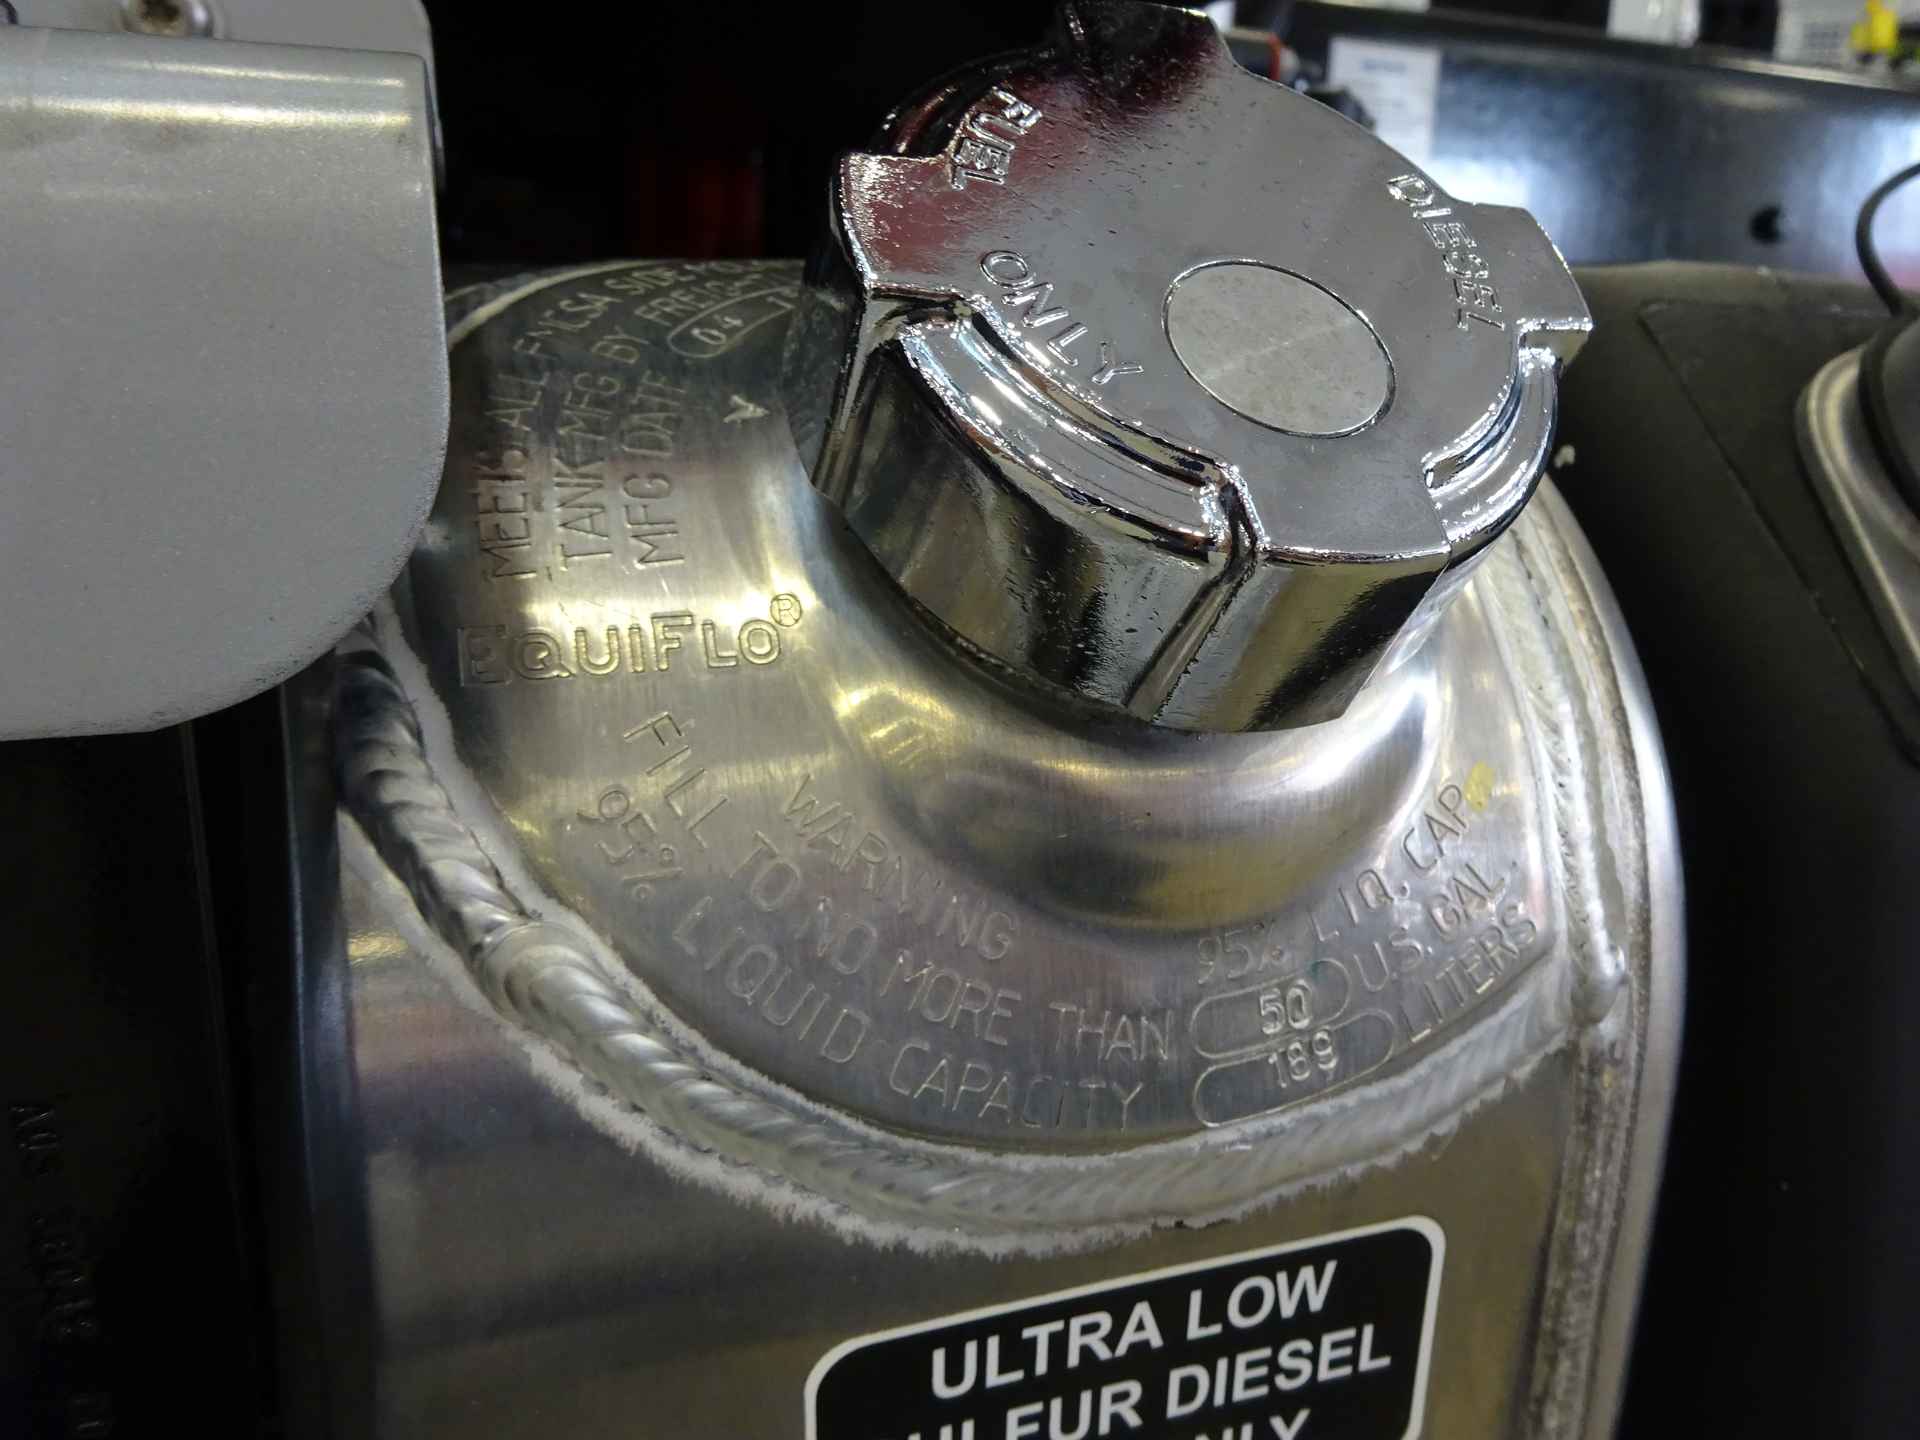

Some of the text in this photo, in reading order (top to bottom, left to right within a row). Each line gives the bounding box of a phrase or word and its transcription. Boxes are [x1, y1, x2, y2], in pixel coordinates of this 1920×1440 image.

[950, 86, 1043, 190] FUEL
[1386, 174, 1506, 331] DIESEL
[590, 324, 650, 365] BY
[980, 250, 1144, 385] ONLY
[484, 371, 550, 432] ALL
[558, 372, 621, 441] MFG
[621, 370, 687, 457] DATE
[553, 455, 614, 572] TANK
[621, 472, 685, 568] MFG
[622, 711, 1173, 1061] FILL TO NO MORE THAN
[783, 772, 1019, 960] WARNING
[576, 789, 1144, 1133] 95% LIQUID CAPACITY
[1197, 919, 1284, 985] 95%
[1268, 903, 1537, 1088] 189 LITERS
[1258, 979, 1312, 1036] 50
[932, 1260, 1337, 1399] ULTRA LOW
[1167, 1324, 1391, 1419] DIESEL
